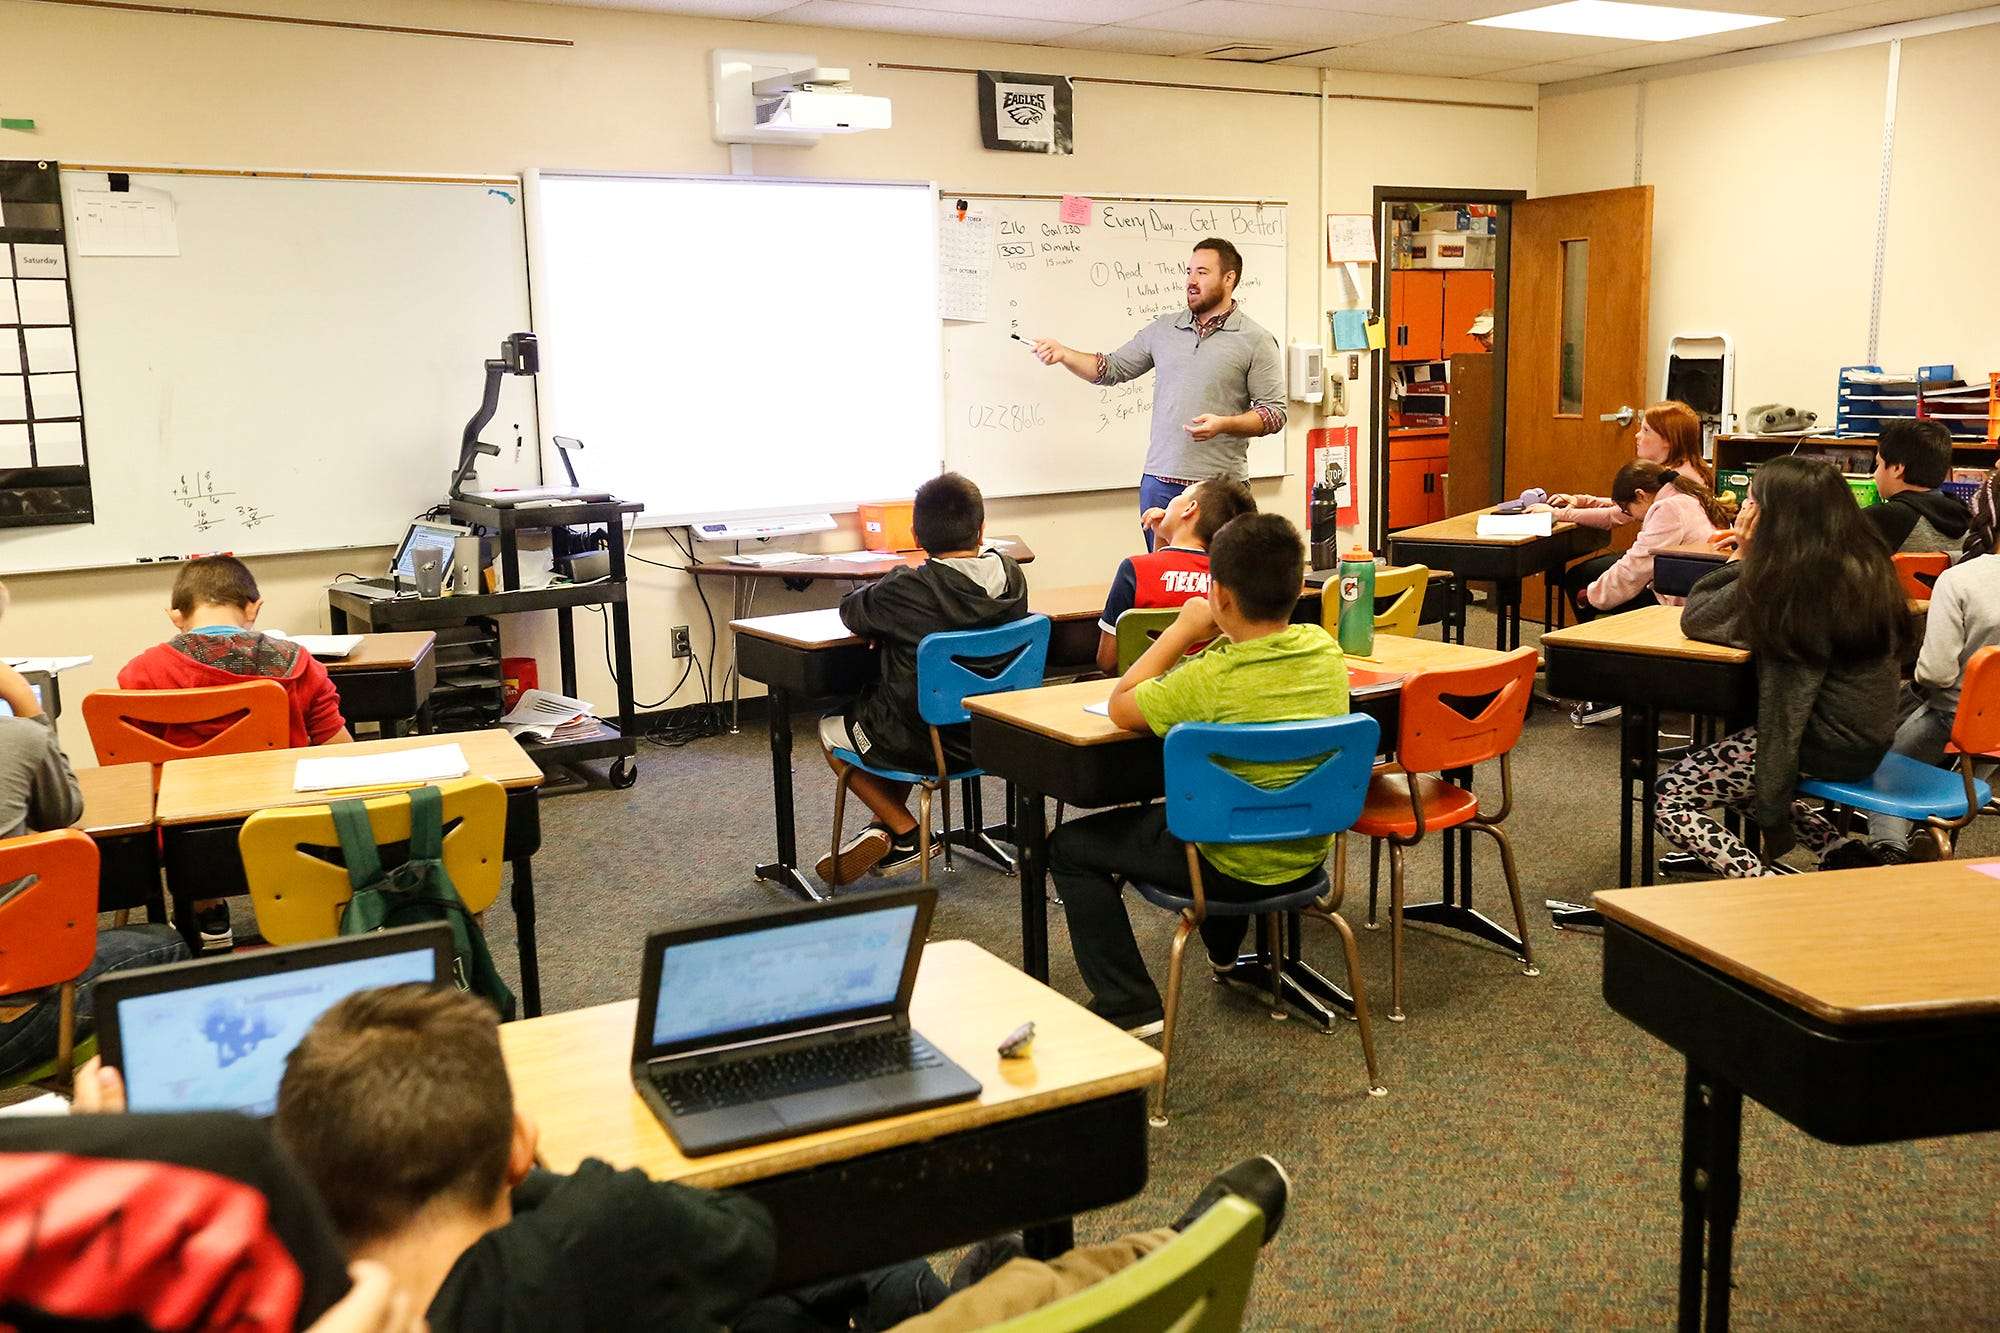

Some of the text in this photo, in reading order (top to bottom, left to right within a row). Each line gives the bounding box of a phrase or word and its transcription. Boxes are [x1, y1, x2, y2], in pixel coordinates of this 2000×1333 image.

[1003, 92, 1046, 111] EAGLES
[1001, 220, 1026, 235] 216
[1063, 224, 1081, 235] 230
[1103, 206, 1148, 239] Every
[1190, 208, 1218, 232] Get
[1001, 246, 1025, 257] 300
[23, 256, 58, 266] Saturday
[1114, 260, 1144, 281] Read
[1137, 283, 1160, 297] What
[1138, 302, 1159, 314] What
[1340, 577, 1359, 602] G
